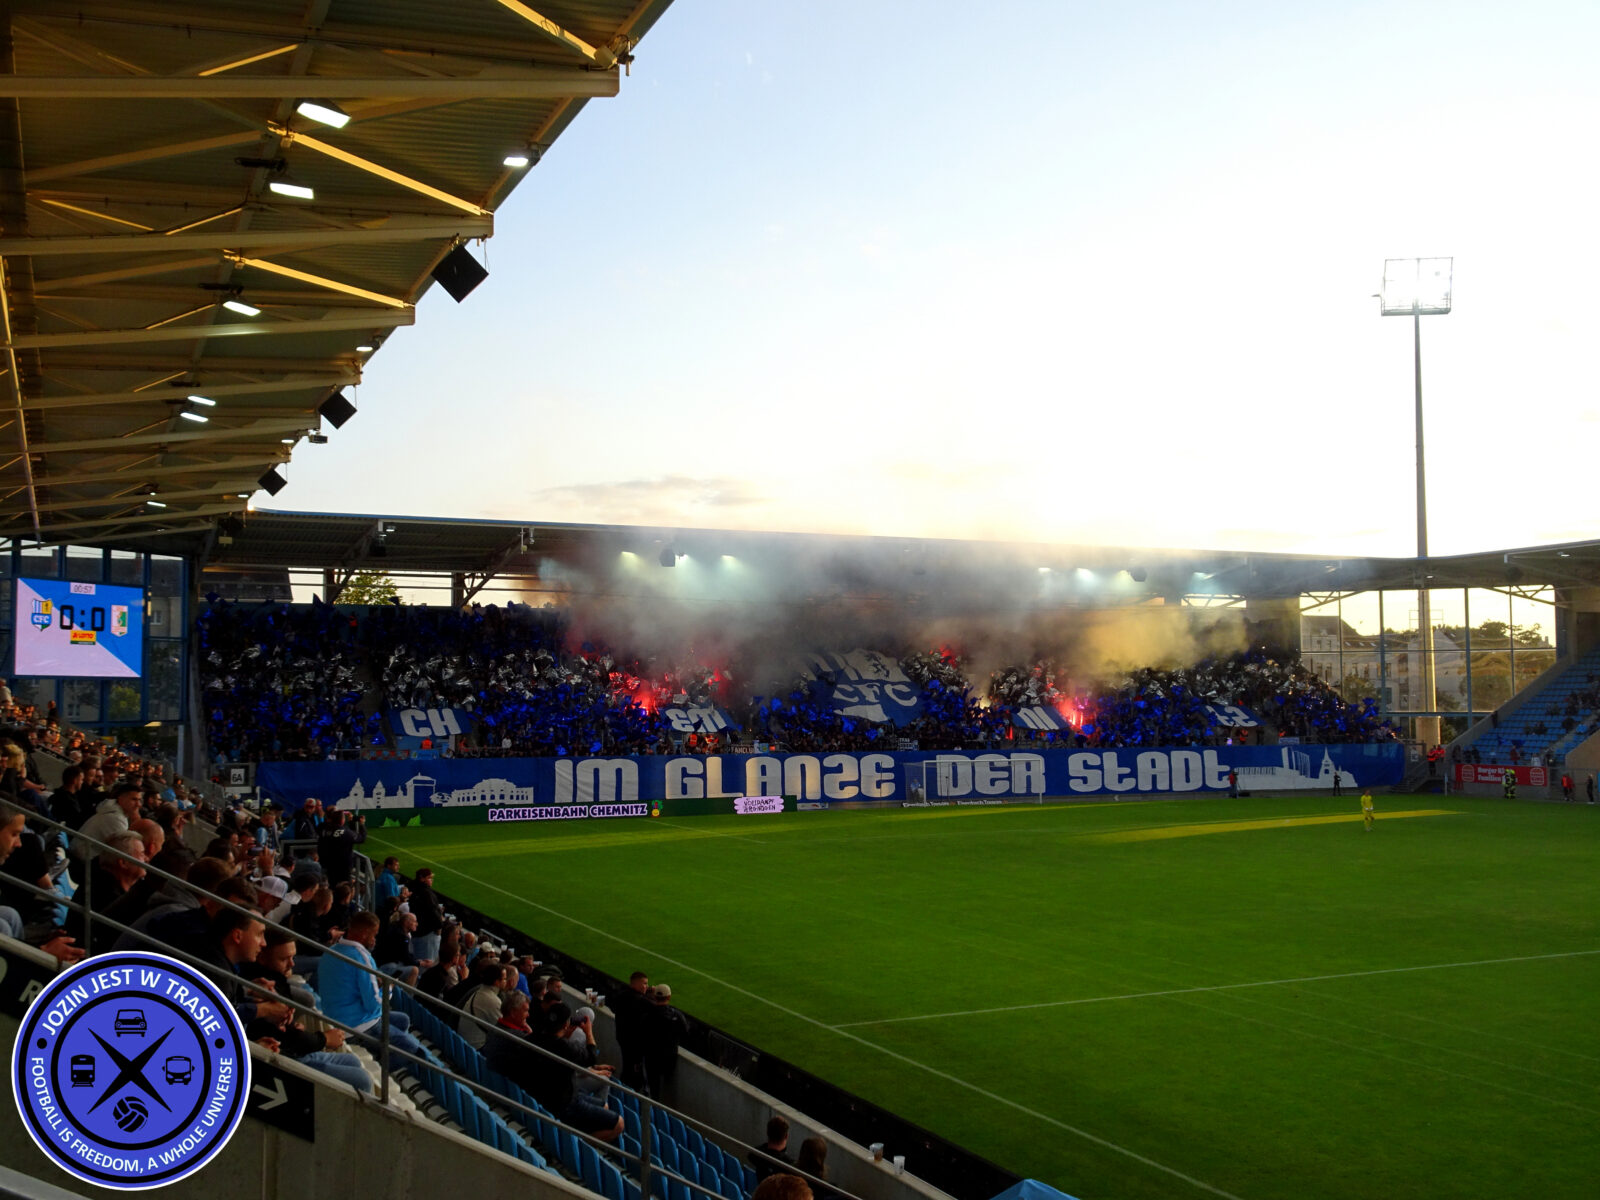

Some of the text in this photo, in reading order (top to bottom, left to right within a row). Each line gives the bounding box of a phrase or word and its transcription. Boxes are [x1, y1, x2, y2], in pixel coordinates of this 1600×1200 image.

[33, 615, 50, 623] CFC
[60, 605, 105, 631] 0:0
[399, 707, 462, 737] CH
[489, 803, 647, 821] PARKEISENBAHN CHEMNITZ
